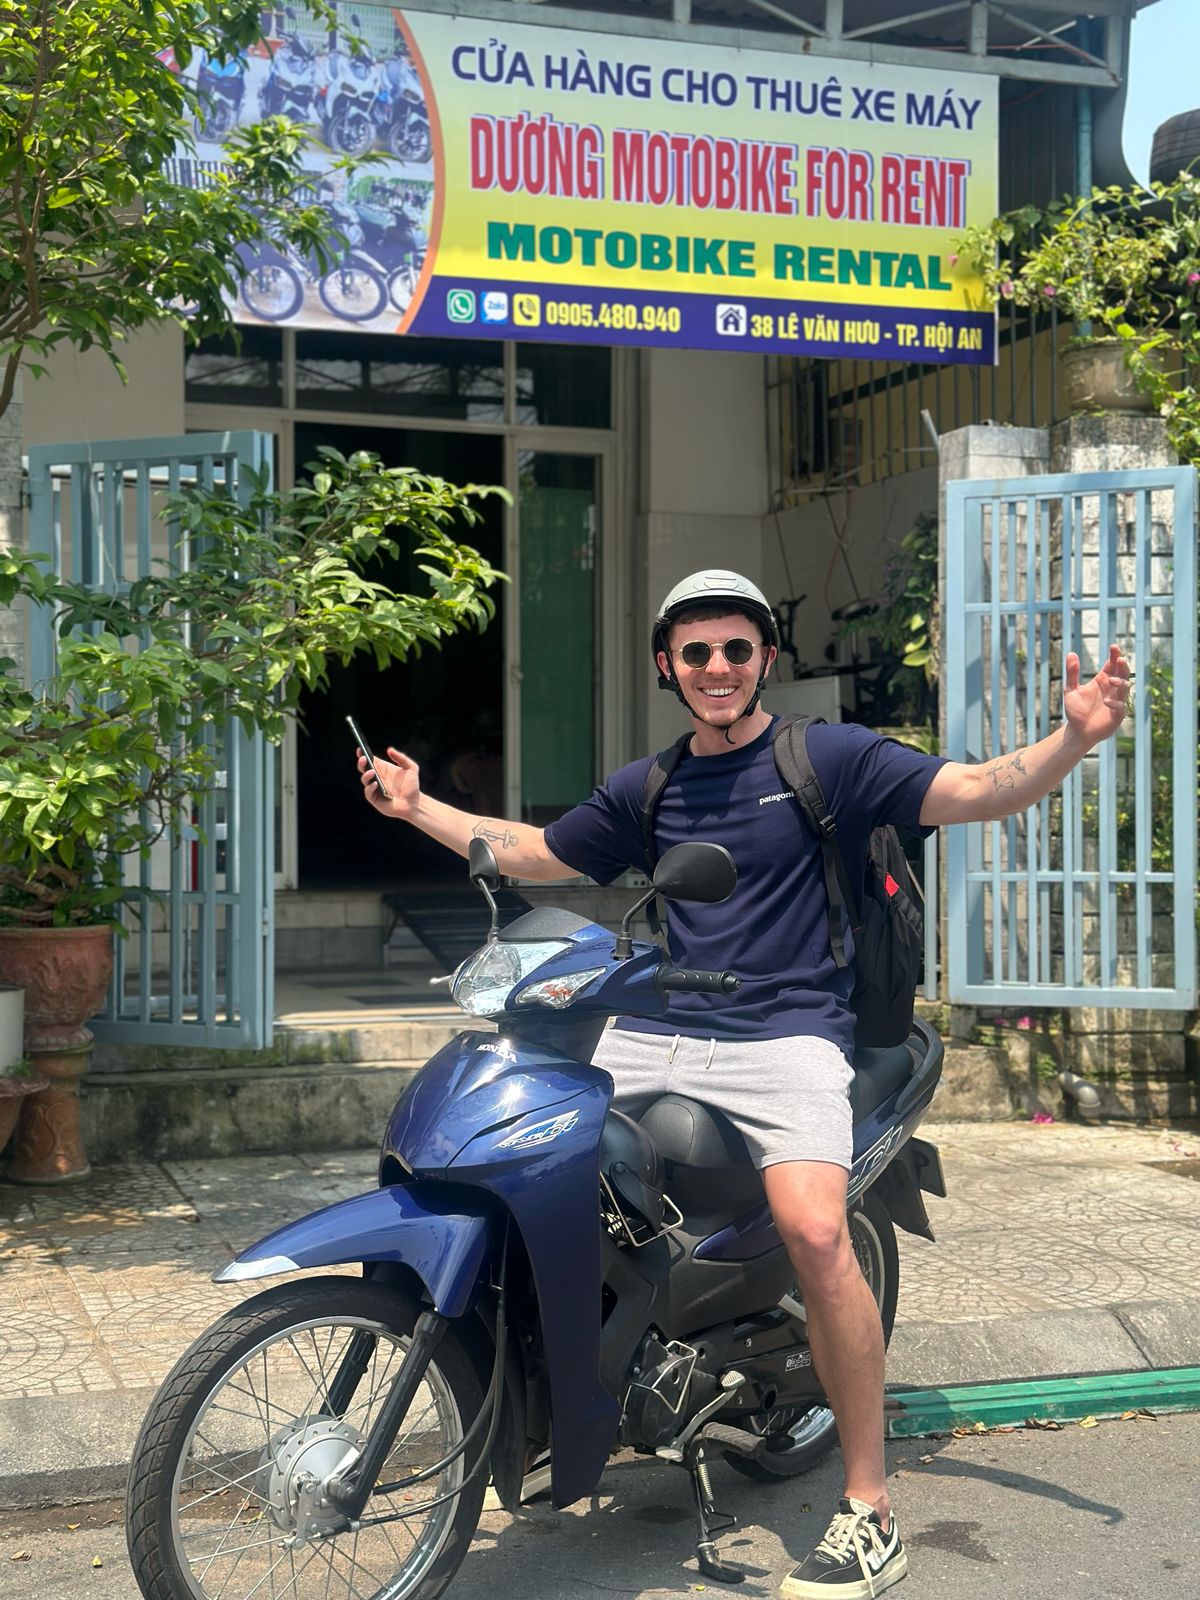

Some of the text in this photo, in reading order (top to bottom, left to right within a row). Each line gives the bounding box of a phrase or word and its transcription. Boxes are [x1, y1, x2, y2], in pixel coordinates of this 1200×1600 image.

[452, 38, 981, 130] CỬA HÀNG CHO THUÊ XE MÁY
[470, 111, 971, 229] DƯƠNG MOTOBIKE FOR RENT
[487, 221, 952, 291] MOTOBIKE RENTAL
[545, 301, 681, 332] 0905.480.940
[751, 315, 773, 338] 38
[778, 312, 799, 339] LÊ
[803, 314, 840, 342] VĂN
[896, 323, 920, 347] TP.
[924, 322, 953, 353] HỘI
[957, 327, 982, 350] AN
[759, 791, 796, 806] patagoni
[476, 1043, 518, 1063] HONDA
